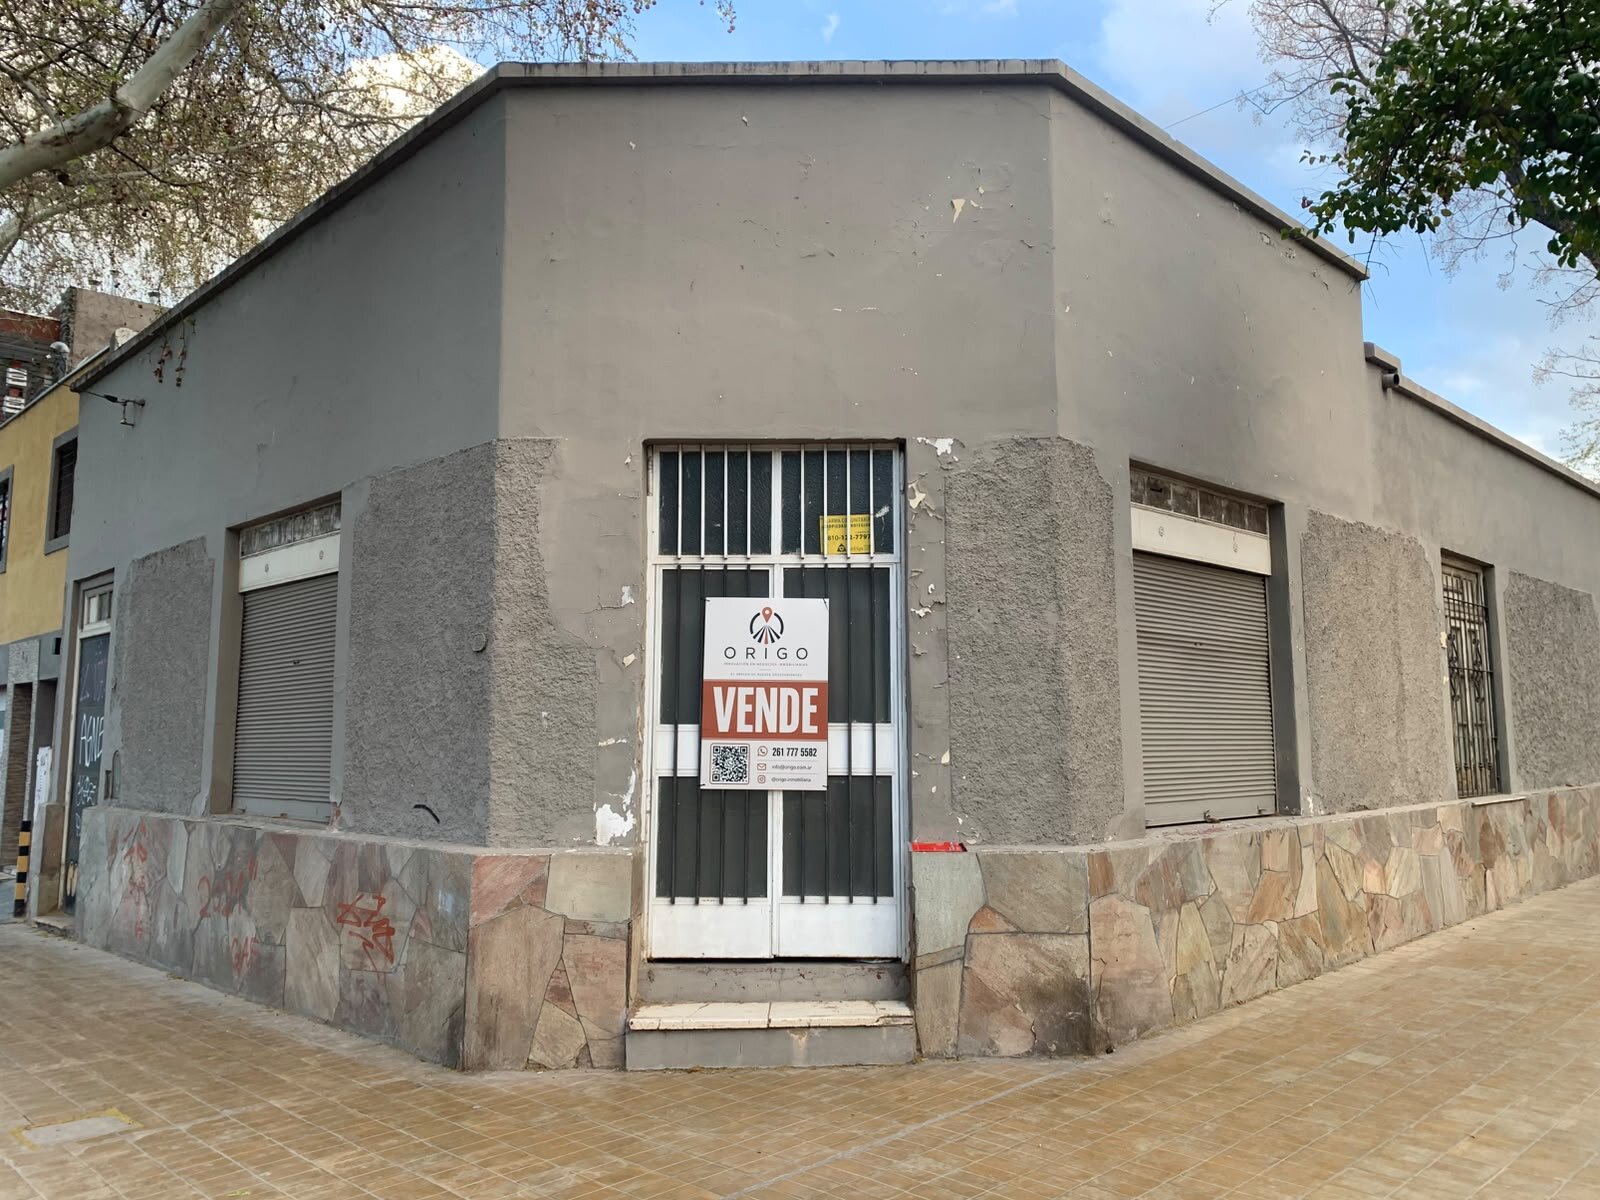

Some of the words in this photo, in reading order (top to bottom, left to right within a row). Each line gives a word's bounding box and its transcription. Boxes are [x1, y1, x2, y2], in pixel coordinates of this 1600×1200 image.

[724, 646, 808, 660] ORIGO
[713, 686, 819, 734] VENDE
[772, 747, 784, 757] 261
[786, 747, 799, 757] 777
[801, 747, 817, 757] 5582
